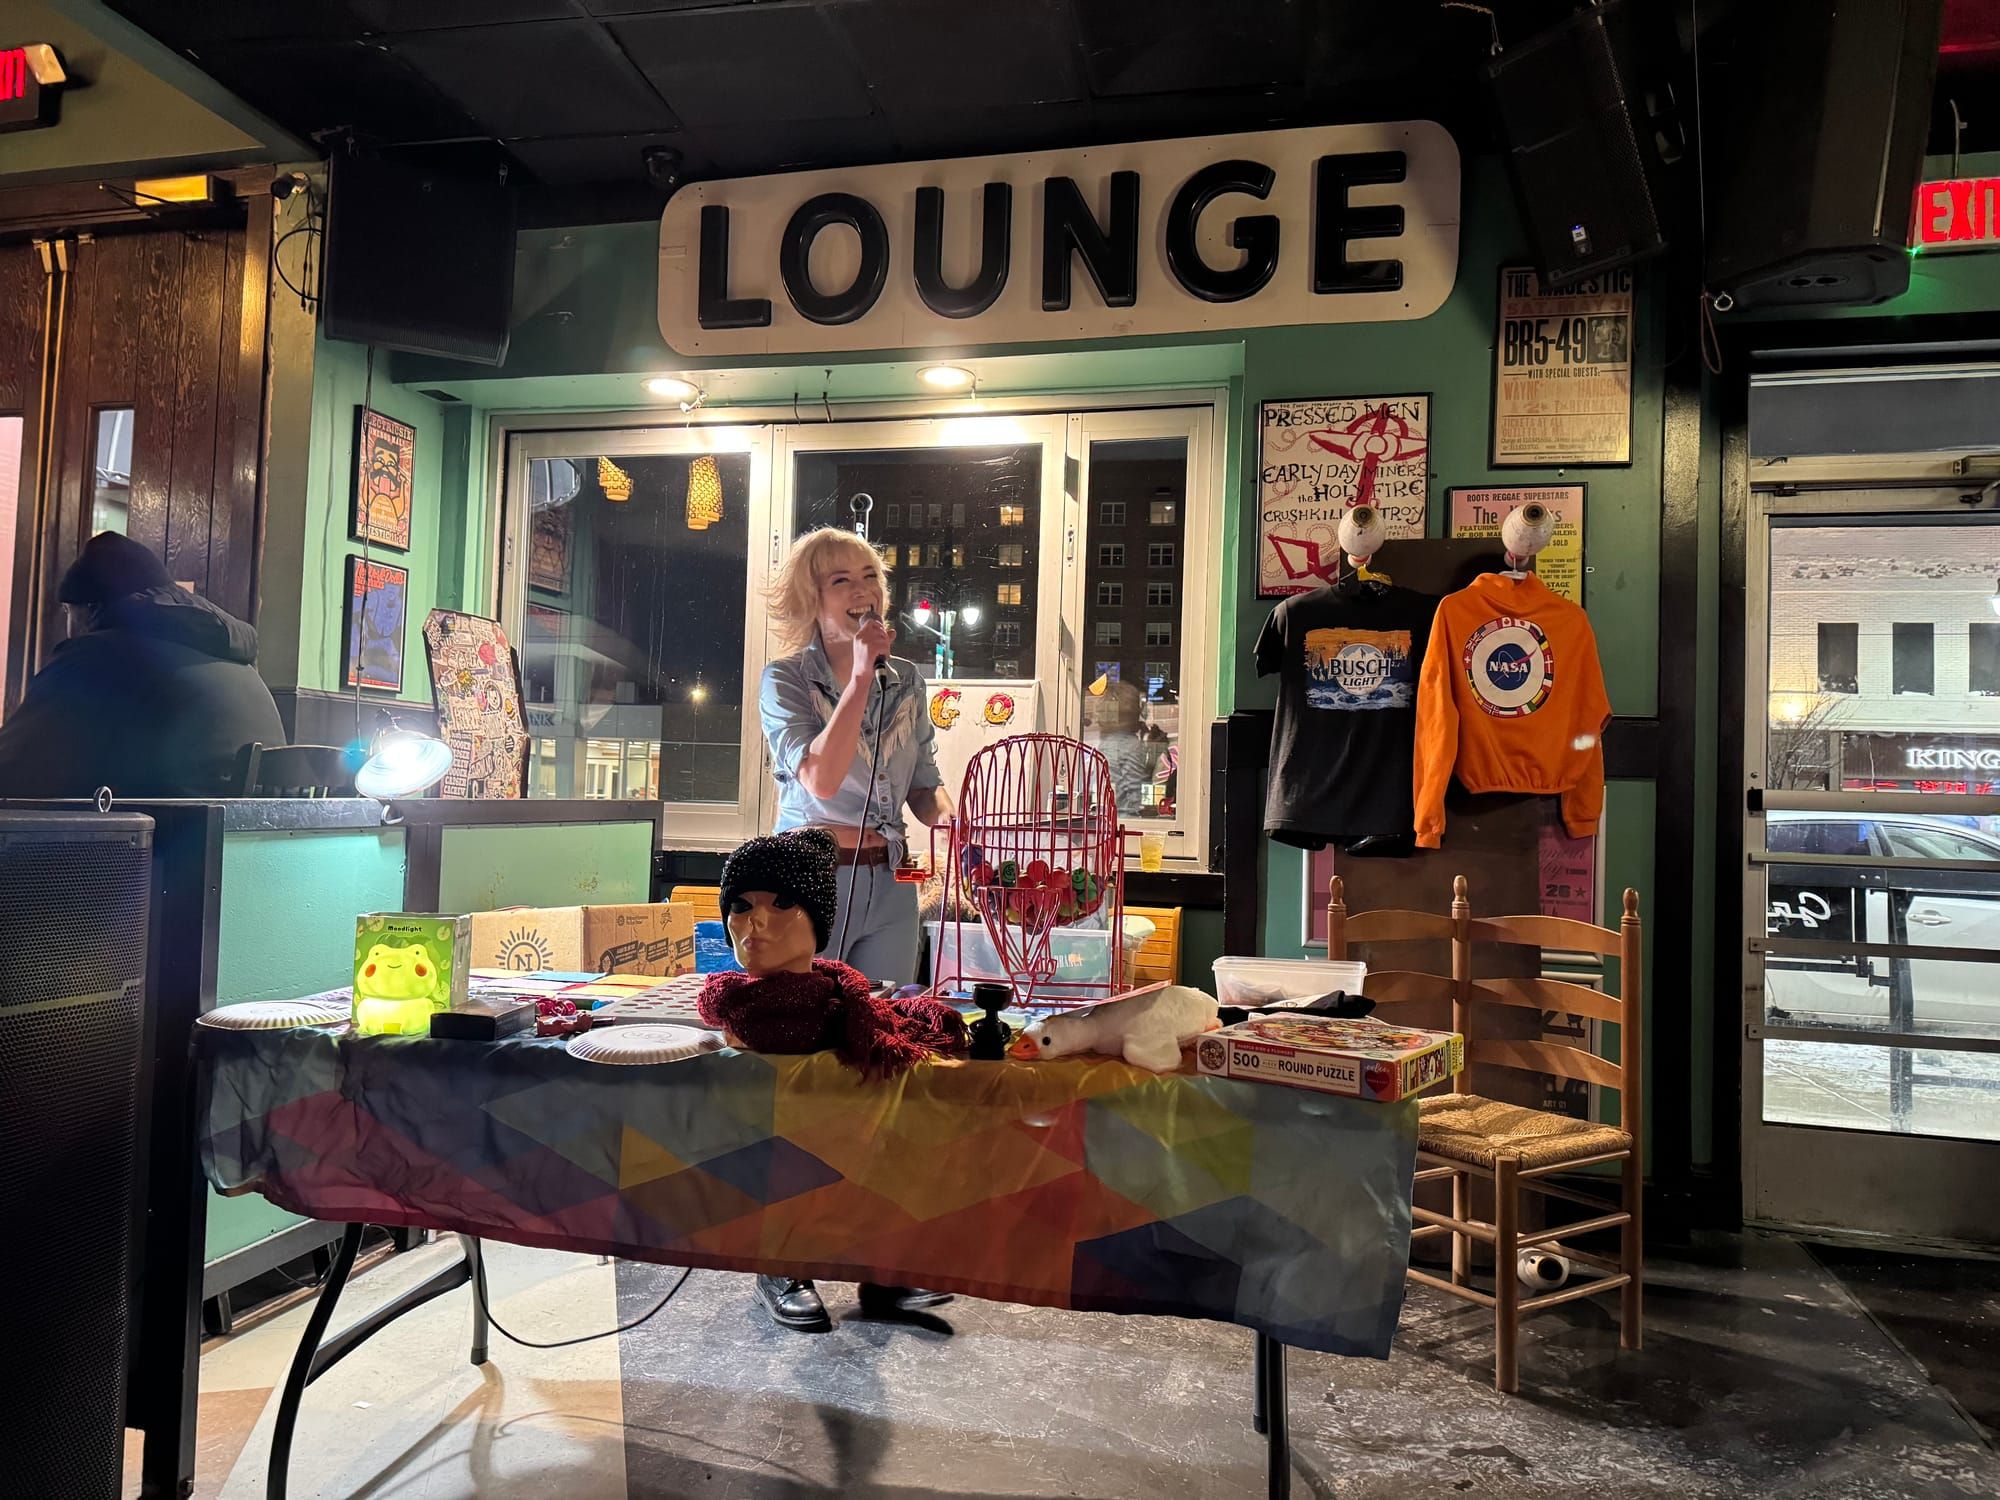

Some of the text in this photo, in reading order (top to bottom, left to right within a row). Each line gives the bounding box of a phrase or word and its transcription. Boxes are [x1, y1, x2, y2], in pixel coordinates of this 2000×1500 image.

[698, 150, 1407, 330] LOUNGE
[1506, 273, 1530, 299] THE
[1504, 318, 1587, 366] BR5-49
[1528, 369, 1543, 380] WITH
[1545, 368, 1571, 379] SPECIAL
[1264, 401, 1420, 426] PRESSED MEN
[1263, 461, 1428, 486] EARLY DAY MINERS
[1298, 479, 1424, 504] the HOLY FIRE
[1467, 491, 1569, 502] ROOTS REGGAE SUPERSTARS
[1473, 506, 1498, 524] The
[1552, 529, 1577, 537] AILERS
[1330, 658, 1391, 677] BUSCH
[1490, 661, 1529, 674] NASA
[1343, 677, 1378, 687] LIGHT
[387, 925, 422, 934] Moodlight
[1233, 1052, 1260, 1068] 500
[1278, 1060, 1314, 1075] ROUND
[1316, 1065, 1355, 1081] PUZZLE
